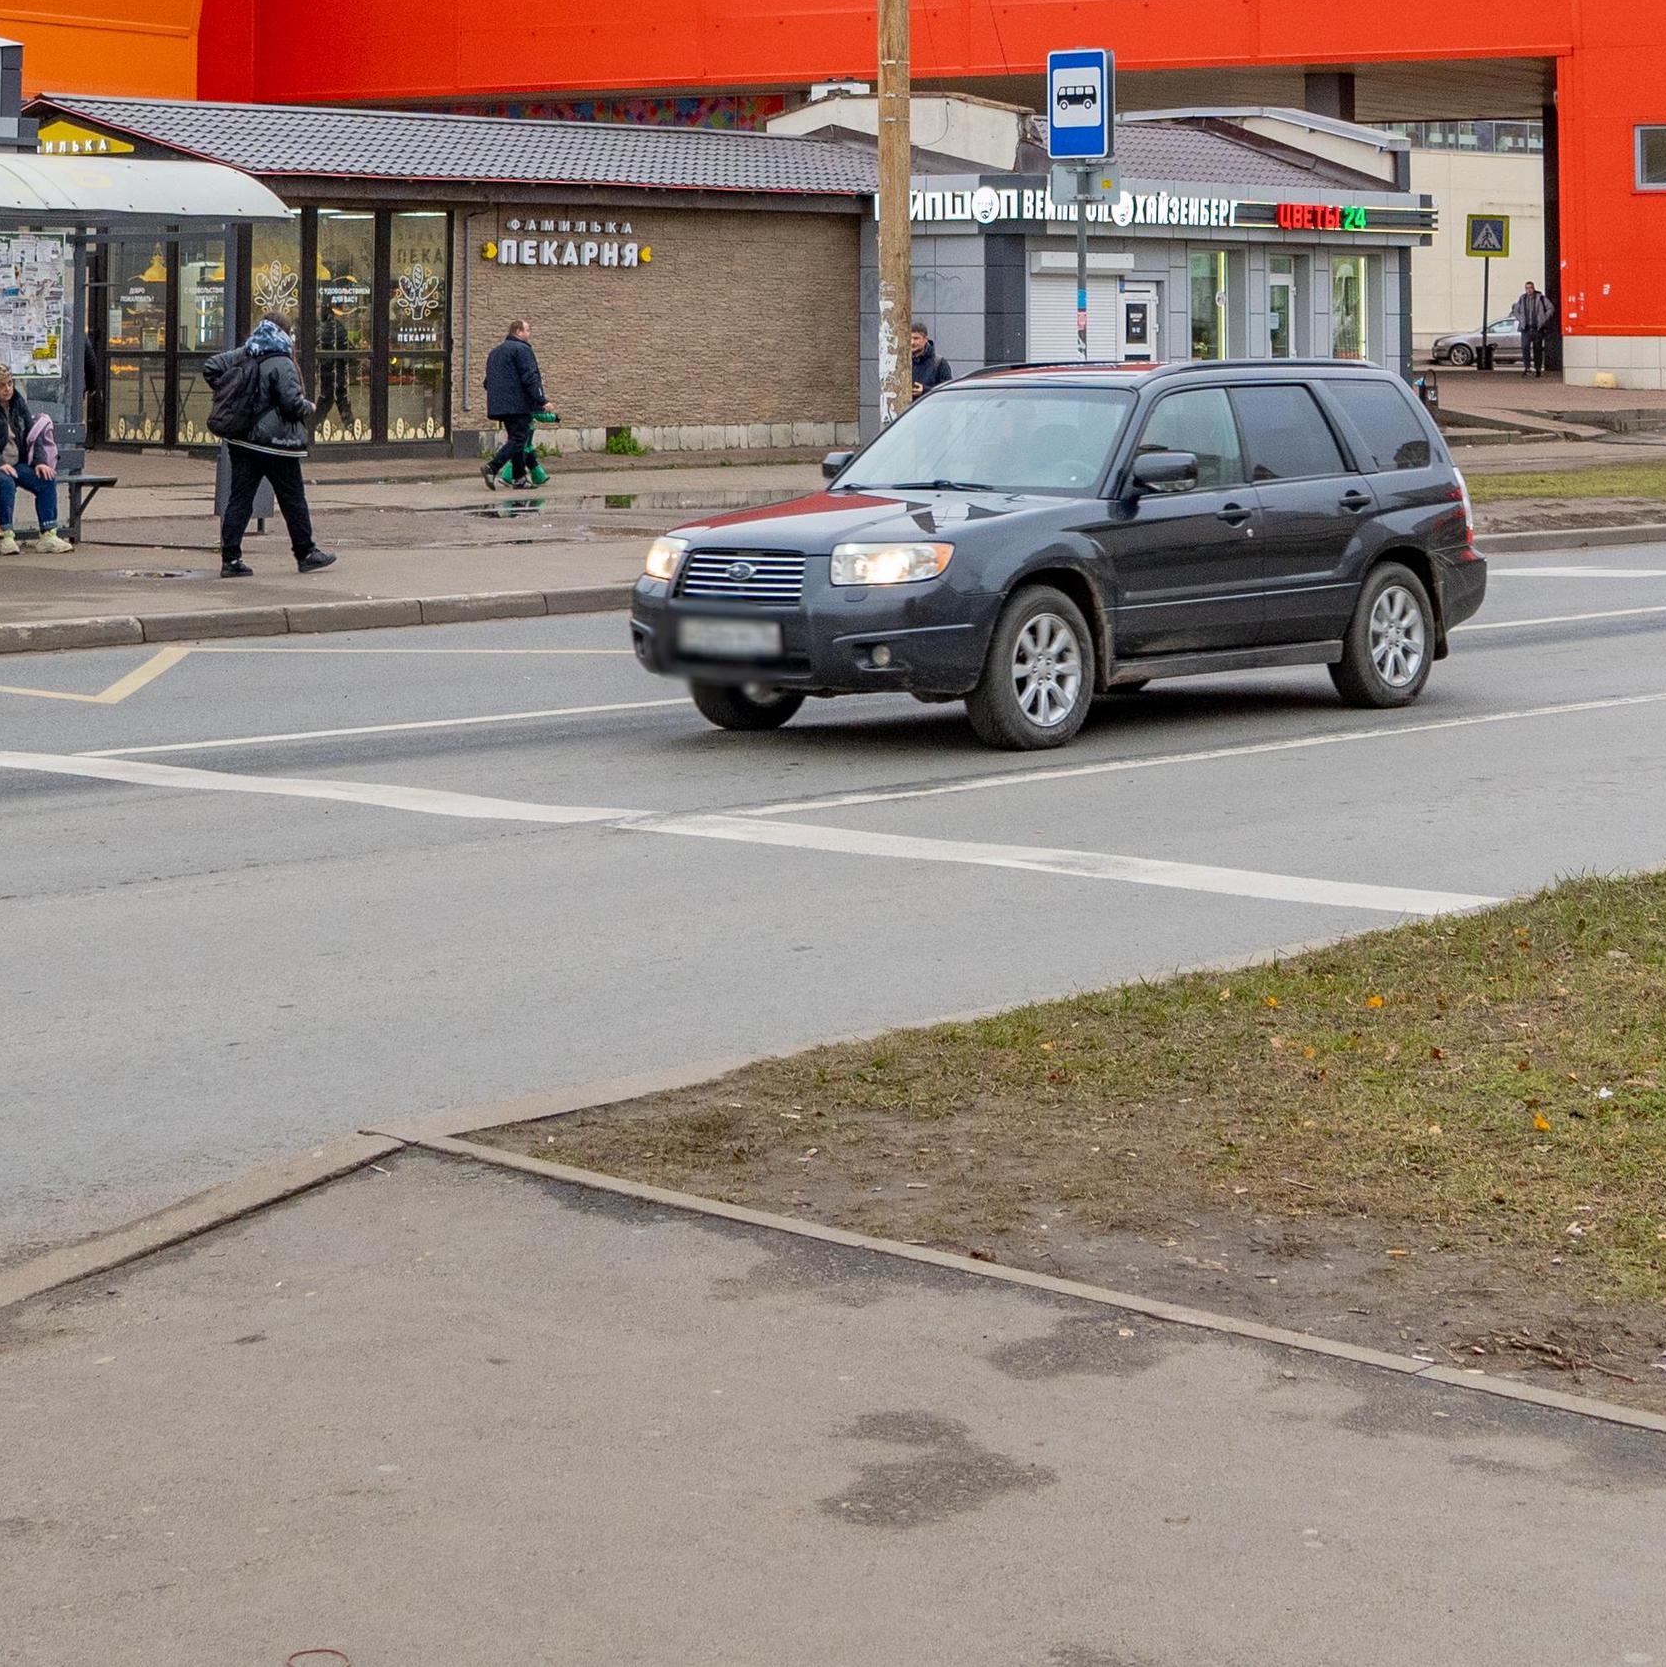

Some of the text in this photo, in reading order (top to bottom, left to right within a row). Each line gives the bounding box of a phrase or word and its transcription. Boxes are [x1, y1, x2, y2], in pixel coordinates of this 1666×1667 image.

[1135, 191, 1238, 226] ХАЙЗЕНБЕРГ
[1277, 203, 1367, 230] ЦВЕТЫ 24
[508, 218, 632, 234] ФАМИЛЬКА
[498, 239, 639, 267] ПЕКАРНЯ
